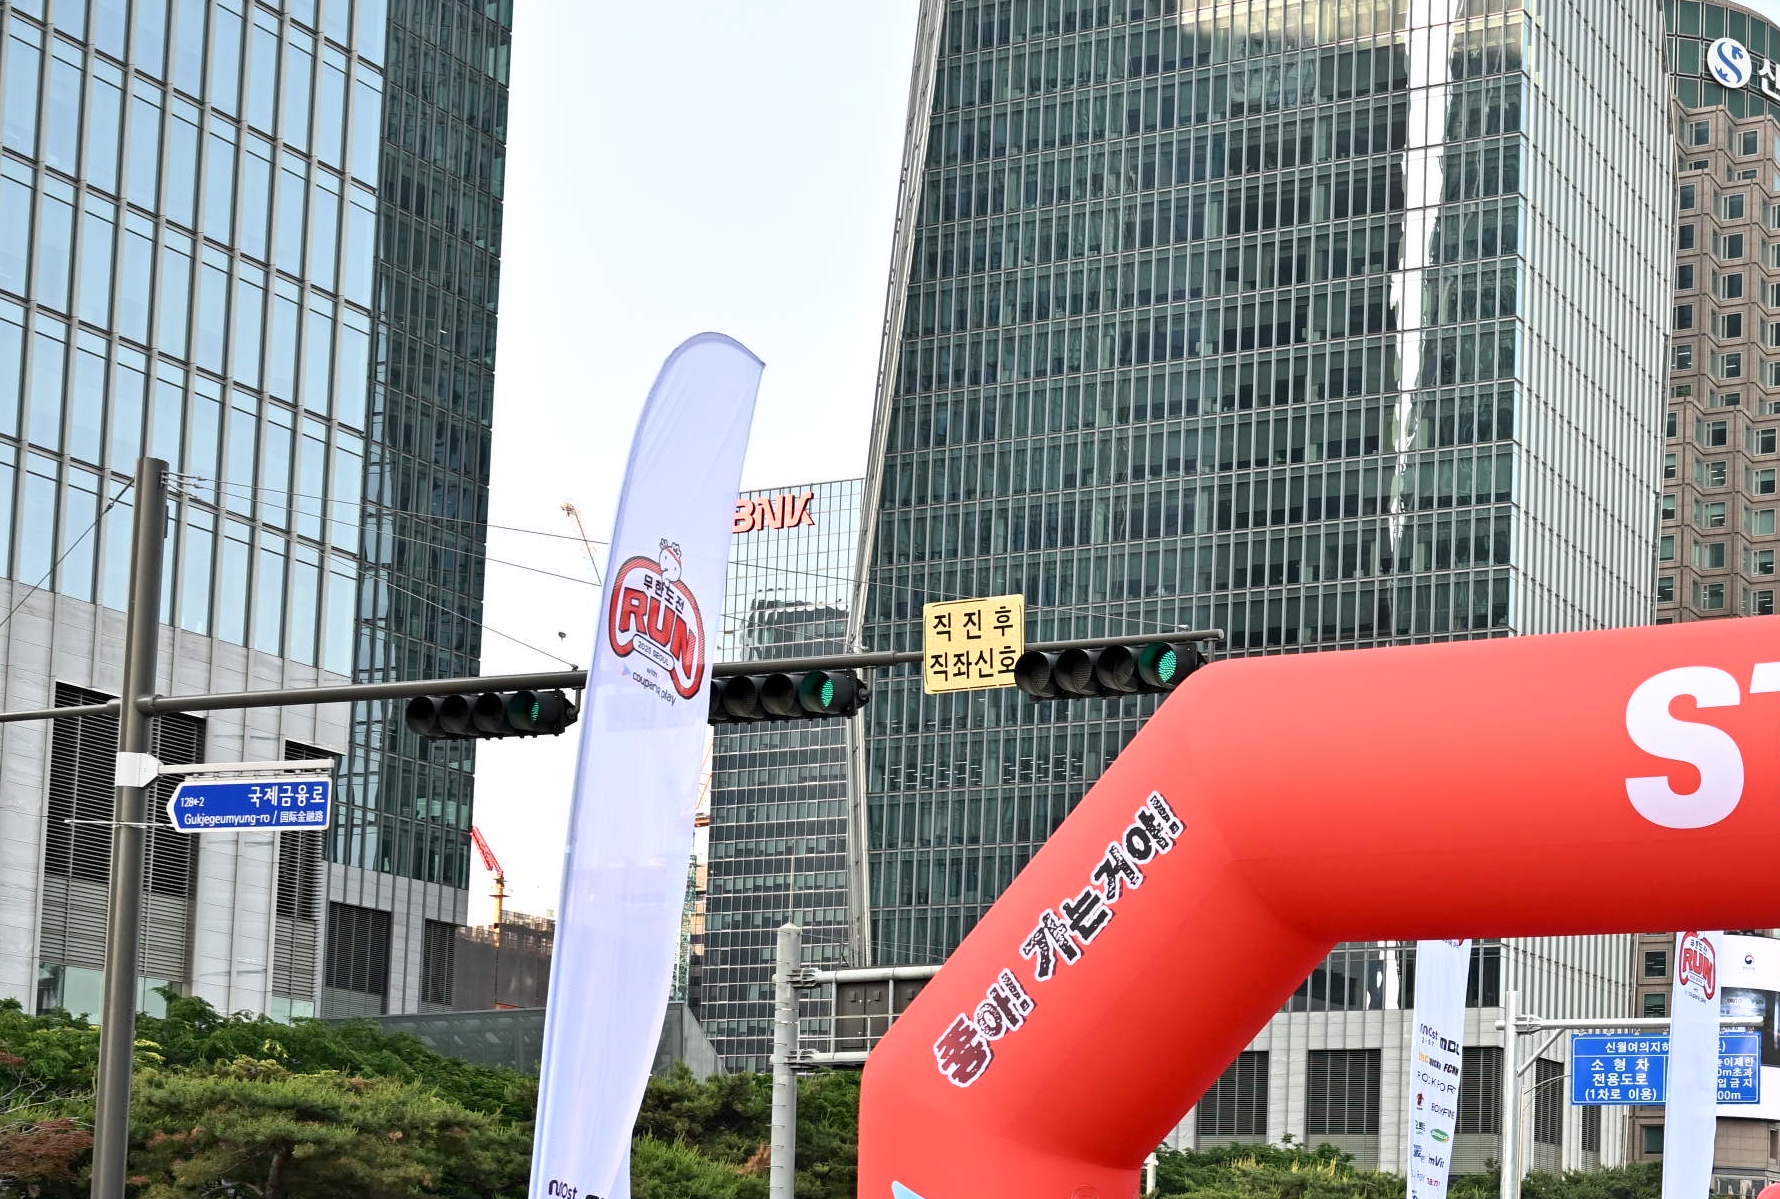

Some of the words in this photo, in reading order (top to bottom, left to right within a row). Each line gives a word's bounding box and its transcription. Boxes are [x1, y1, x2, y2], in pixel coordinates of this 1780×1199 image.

[731, 491, 816, 534] BNK
[643, 573, 686, 614] 무한도전
[618, 586, 697, 680] RUN
[930, 646, 1016, 682] 직좌신호
[248, 785, 325, 807] 국제금융로
[184, 813, 270, 826] Gukjegeumyung-ro
[1021, 792, 1183, 980] 가는거야!
[1683, 948, 1713, 982] RUN
[1585, 1089, 1622, 1100] (1차로
[1628, 1088, 1657, 1100] 이용)
[1592, 1074, 1649, 1086] 전용도로
